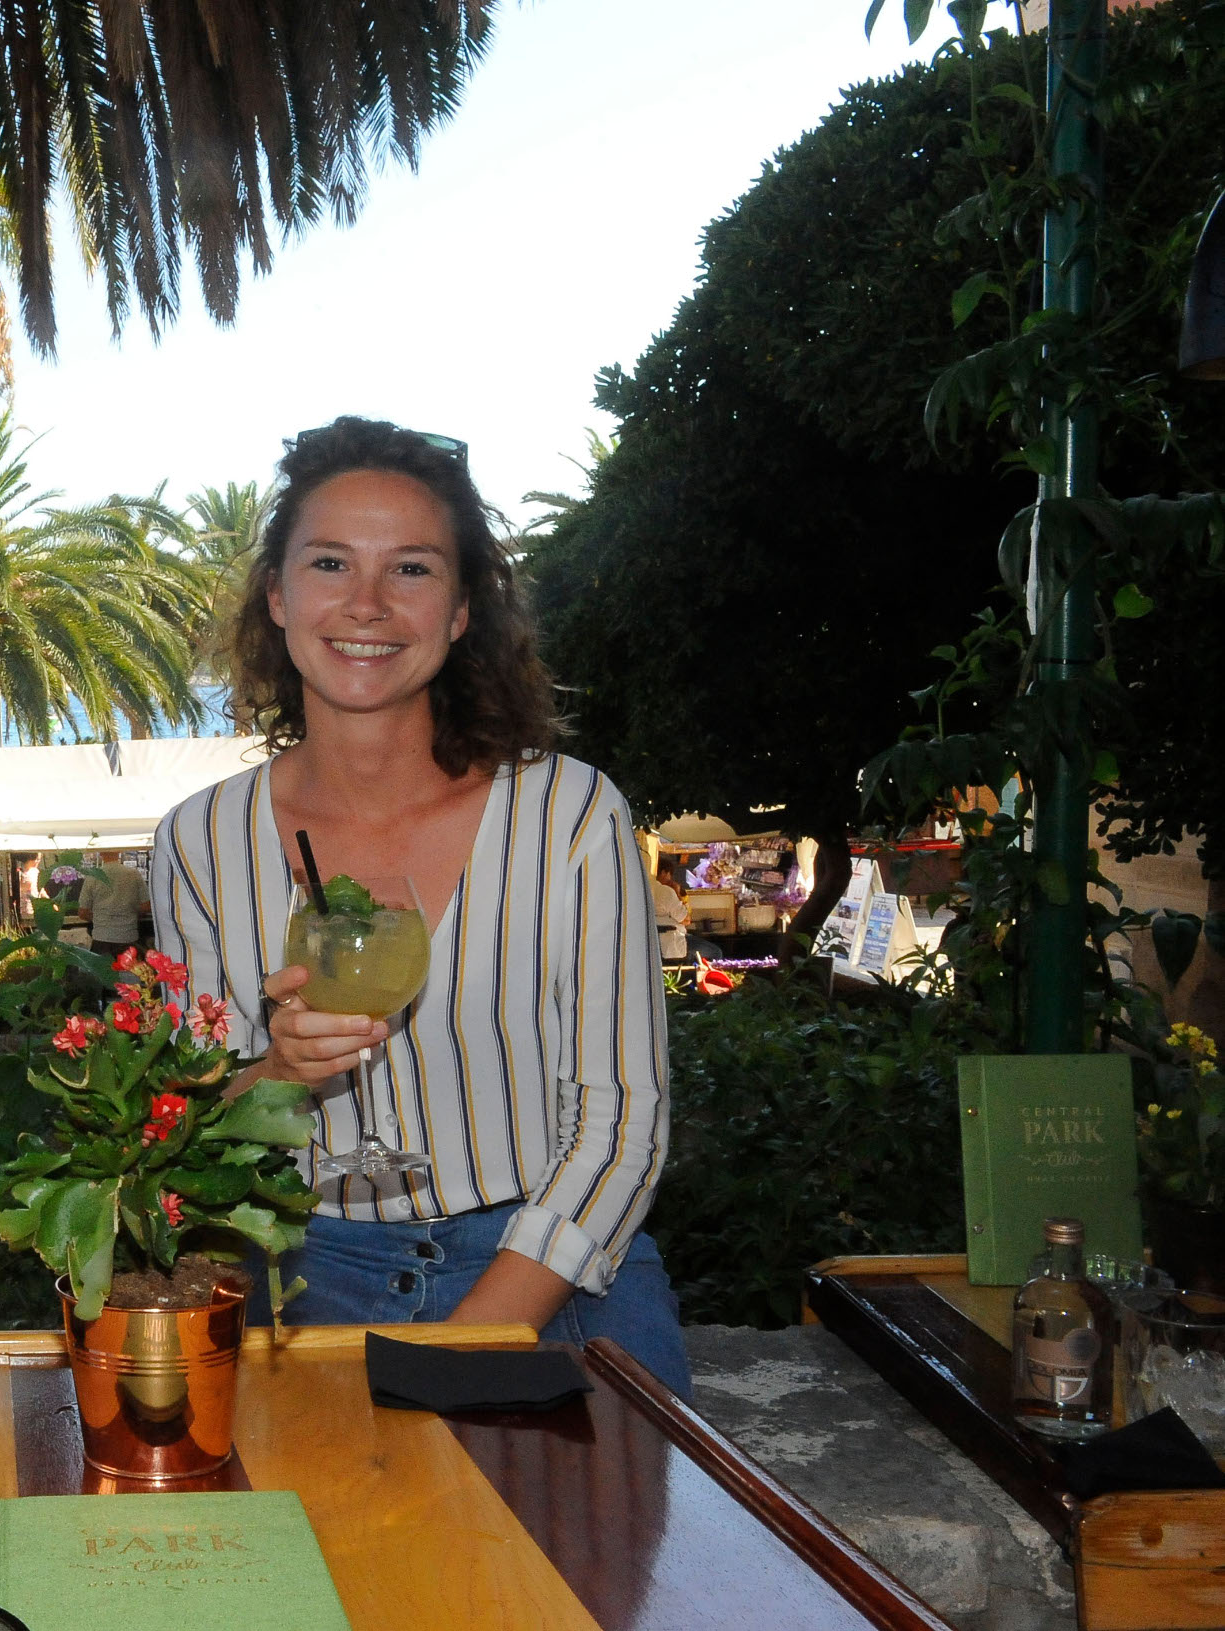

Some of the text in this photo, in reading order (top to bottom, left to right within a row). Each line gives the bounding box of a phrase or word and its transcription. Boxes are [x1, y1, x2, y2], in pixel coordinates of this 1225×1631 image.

[1021, 1106, 1104, 1117] CENTRAL
[1023, 1120, 1104, 1144] PARK
[85, 1533, 249, 1556] PARK
[129, 1557, 199, 1573] Club
